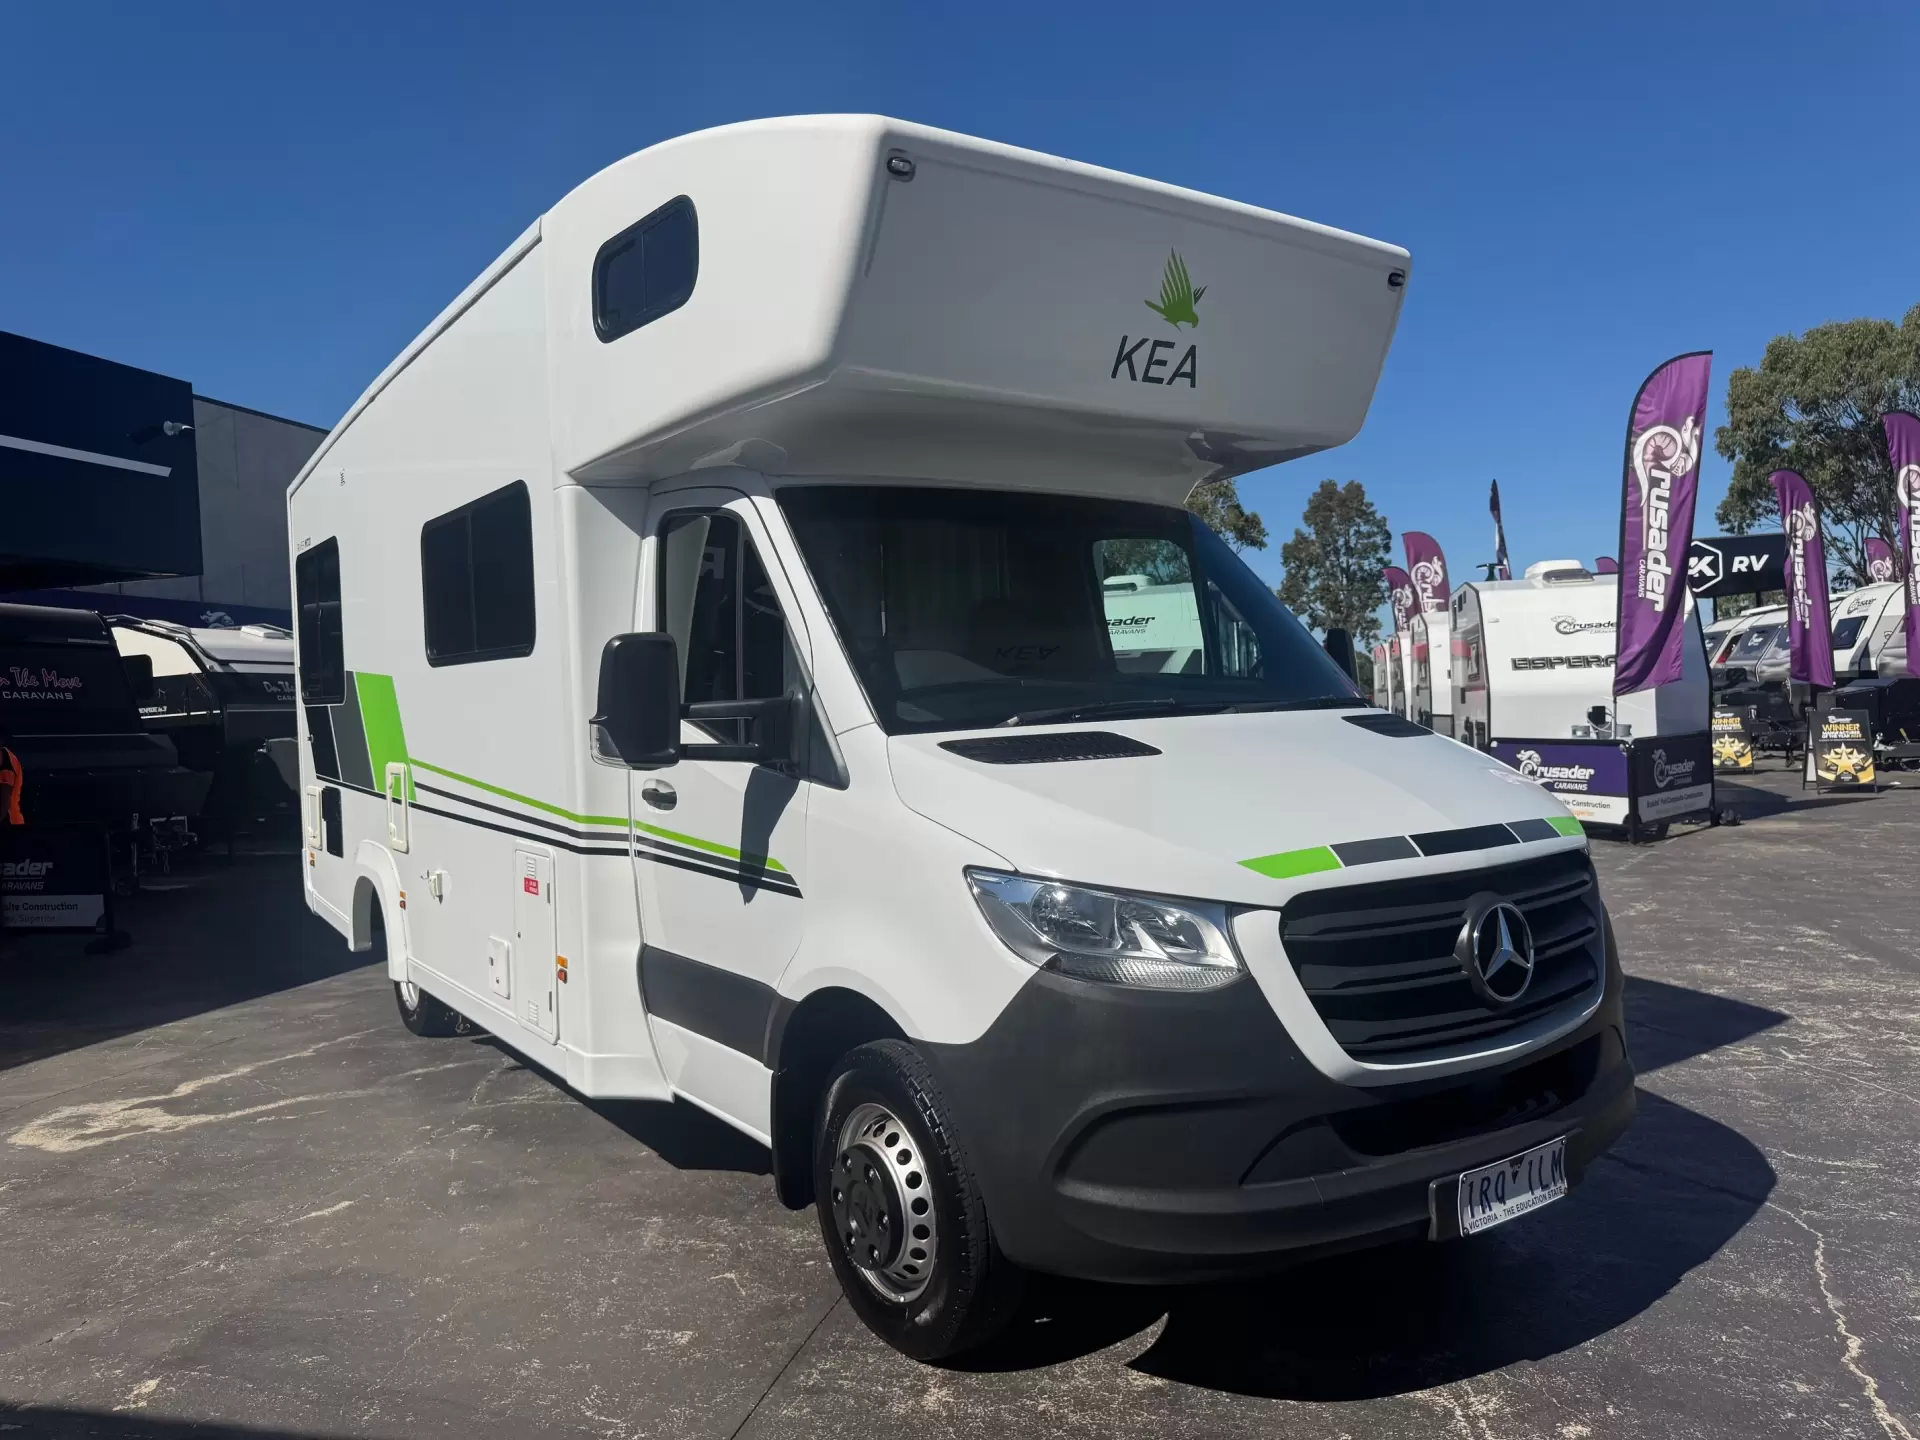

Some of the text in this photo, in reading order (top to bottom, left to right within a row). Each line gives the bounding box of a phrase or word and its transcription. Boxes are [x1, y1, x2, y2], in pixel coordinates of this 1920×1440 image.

[1111, 335, 1197, 388] KEA
[1633, 424, 1683, 612] Crusader
[1732, 554, 1769, 573] RV
[1637, 559, 1646, 598] CARAVANS
[1909, 573, 1918, 605] CARAVANS
[1105, 616, 1155, 627] sader
[1109, 628, 1146, 636] ARAVANS
[1511, 655, 1617, 671] ESPERA
[10, 666, 39, 688] The
[41, 667, 83, 689] Move
[3, 691, 73, 700] CARAVANS
[1821, 723, 1861, 732] WINNER
[1520, 759, 1595, 785] Crusader
[1654, 758, 1696, 788] Crusader
[1554, 781, 1589, 791] CARAVANS
[1571, 799, 1611, 809] Construction
[2, 858, 54, 876] ader
[22, 902, 78, 911] Construction
[1468, 1214, 1499, 1230] VICTORIA
[1503, 1206, 1516, 1218] THE
[1516, 1194, 1547, 1212] EDUCATION
[1547, 1185, 1563, 1201] STATE
